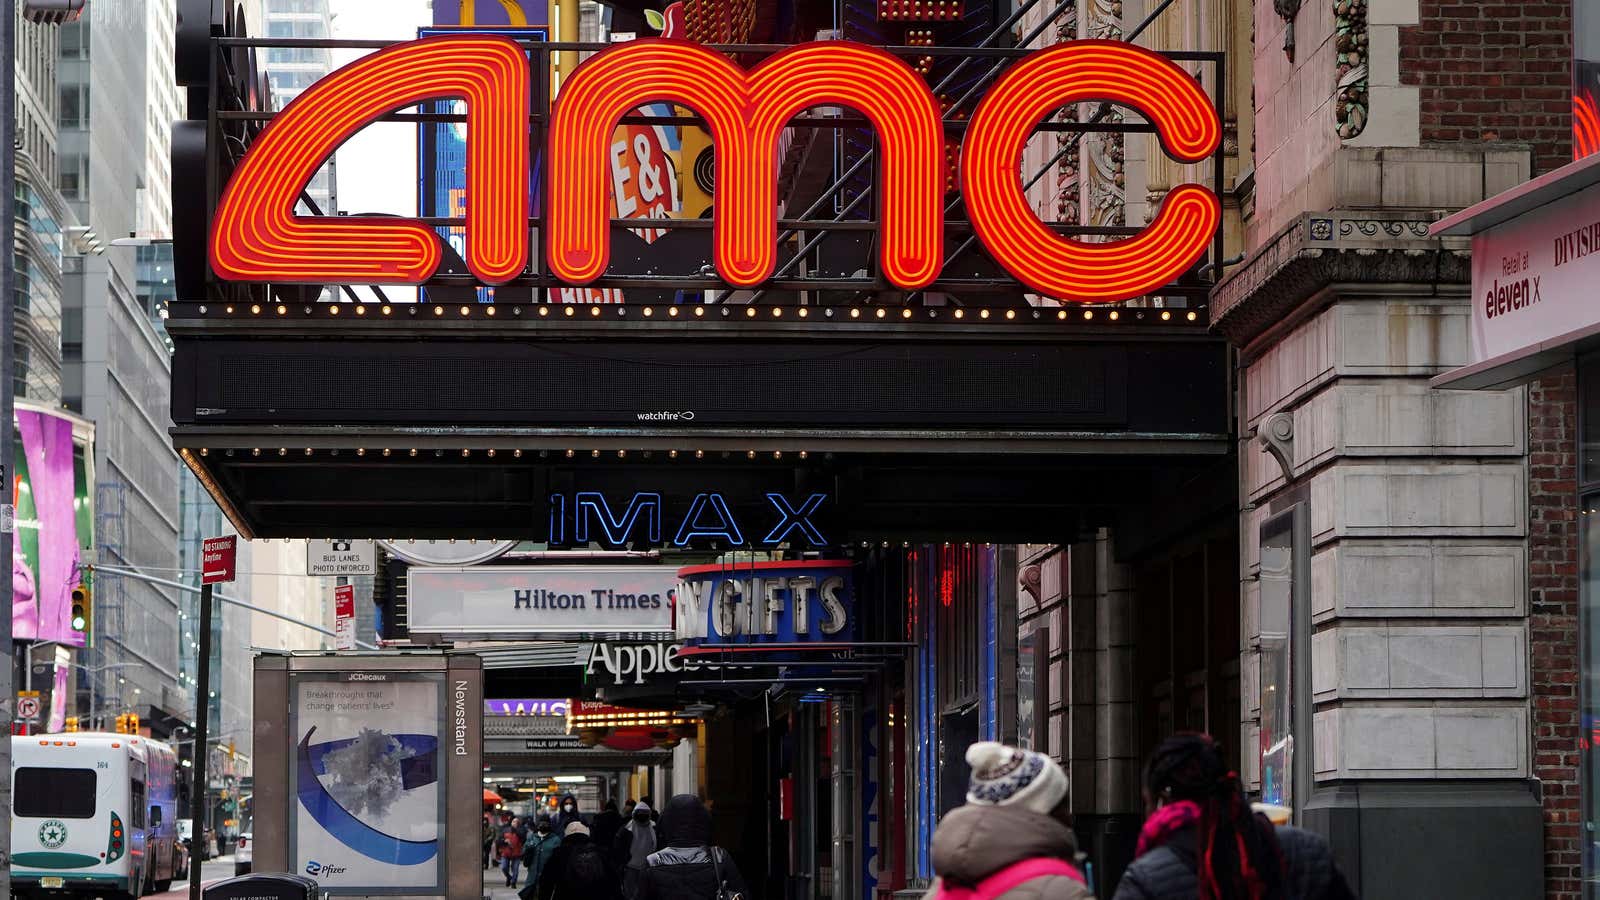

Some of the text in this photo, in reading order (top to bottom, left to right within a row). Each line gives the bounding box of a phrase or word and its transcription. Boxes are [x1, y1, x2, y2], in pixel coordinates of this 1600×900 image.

[211, 38, 1222, 302] amc
[1502, 251, 1529, 277] Retail at
[1486, 279, 1530, 319] eleven
[637, 410, 679, 420] watchfire
[549, 492, 828, 546] IMAX
[204, 541, 232, 551] NO STANDING
[204, 553, 222, 564] Anytime
[338, 554, 360, 562] LANES
[513, 589, 586, 610] Hilton
[591, 589, 661, 610] Times
[348, 673, 386, 681] JCDecaux
[306, 691, 383, 700] Breakthroughs that
[306, 702, 335, 711] change
[455, 680, 468, 755] Newsstand
[527, 740, 547, 748] WALK
[548, 740, 559, 748] UP
[321, 864, 347, 878] Pfizer
